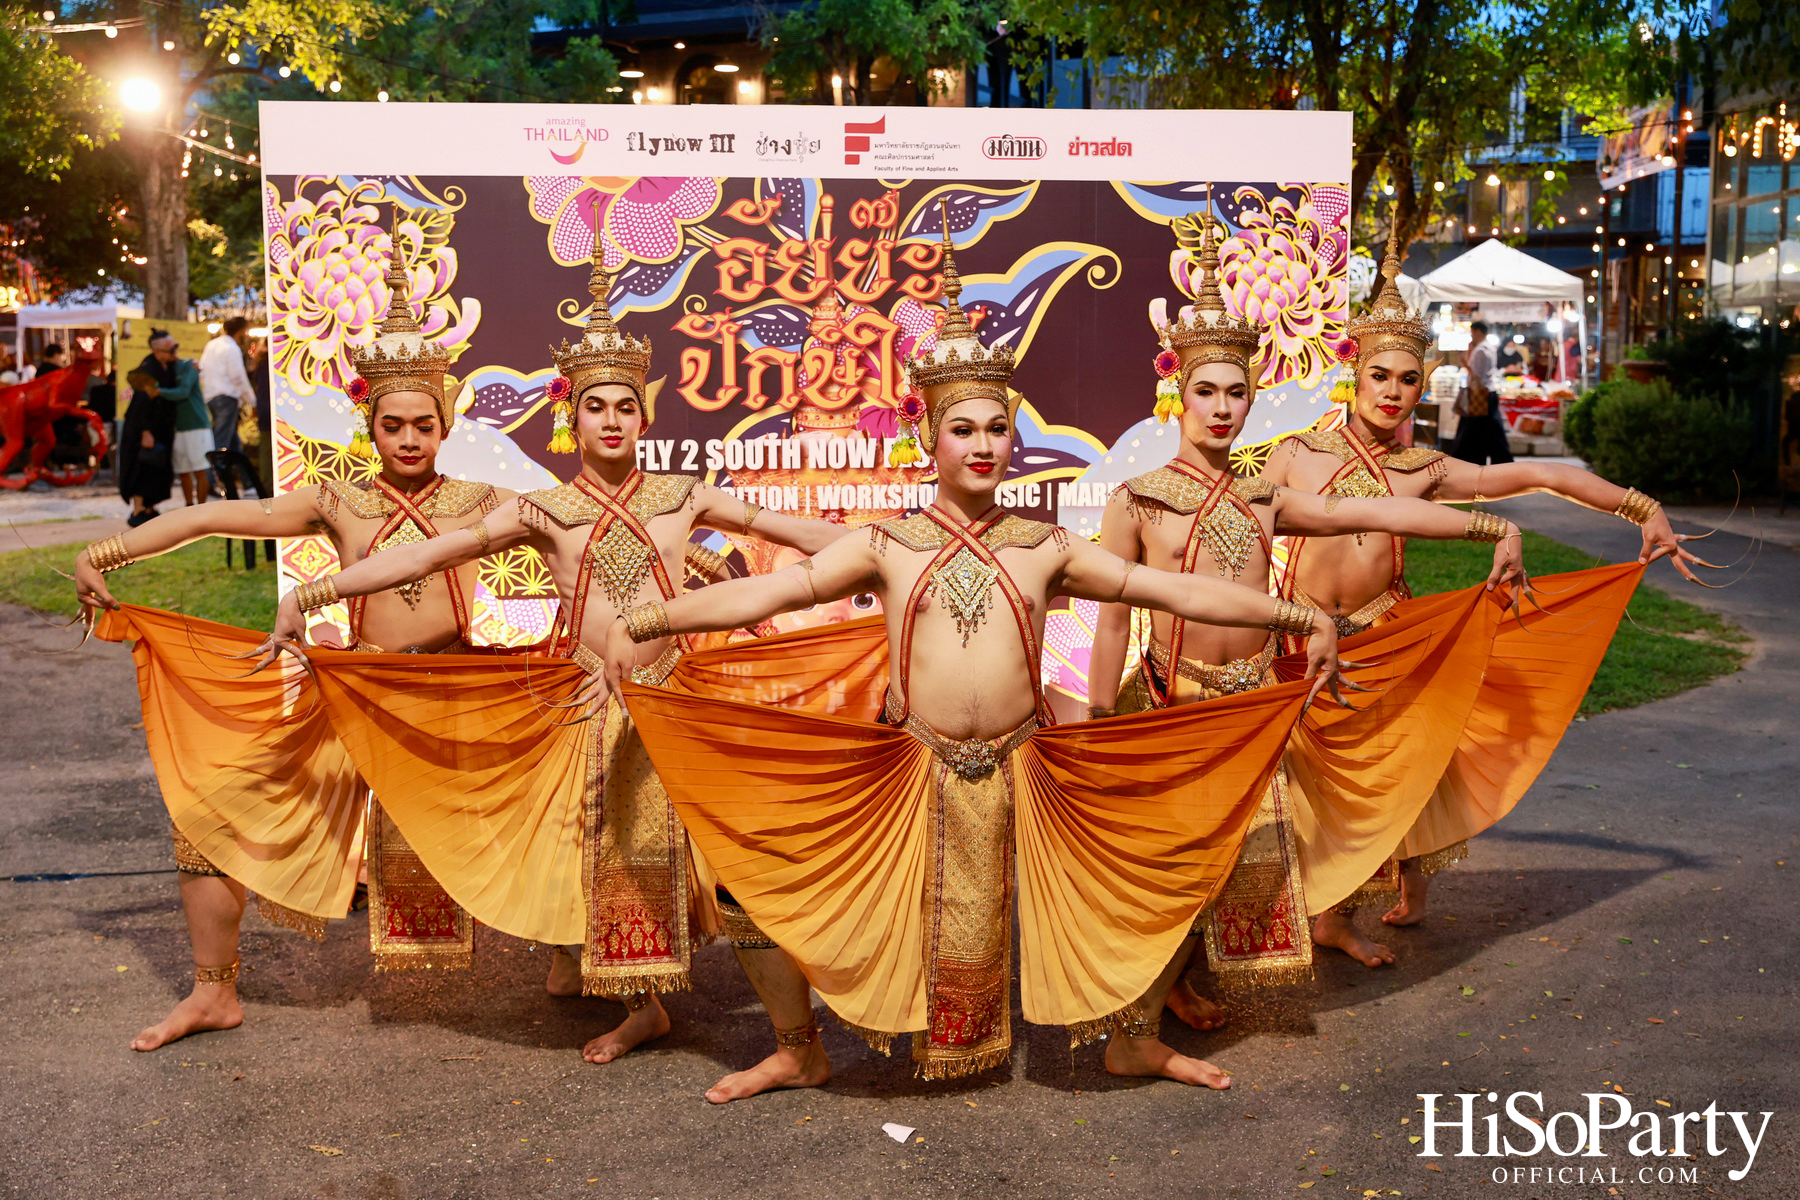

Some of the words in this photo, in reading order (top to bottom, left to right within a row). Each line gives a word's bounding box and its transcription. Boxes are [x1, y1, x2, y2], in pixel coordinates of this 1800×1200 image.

[546, 116, 586, 127] amazing
[523, 127, 609, 142] THAILAND
[626, 132, 703, 156] flynow
[988, 134, 1043, 157] มติชน
[1068, 136, 1132, 157] ข่าวสด
[635, 439, 675, 471] FLY
[680, 439, 699, 471] 2
[705, 438, 801, 471] SOUTH
[808, 437, 877, 469] NOW
